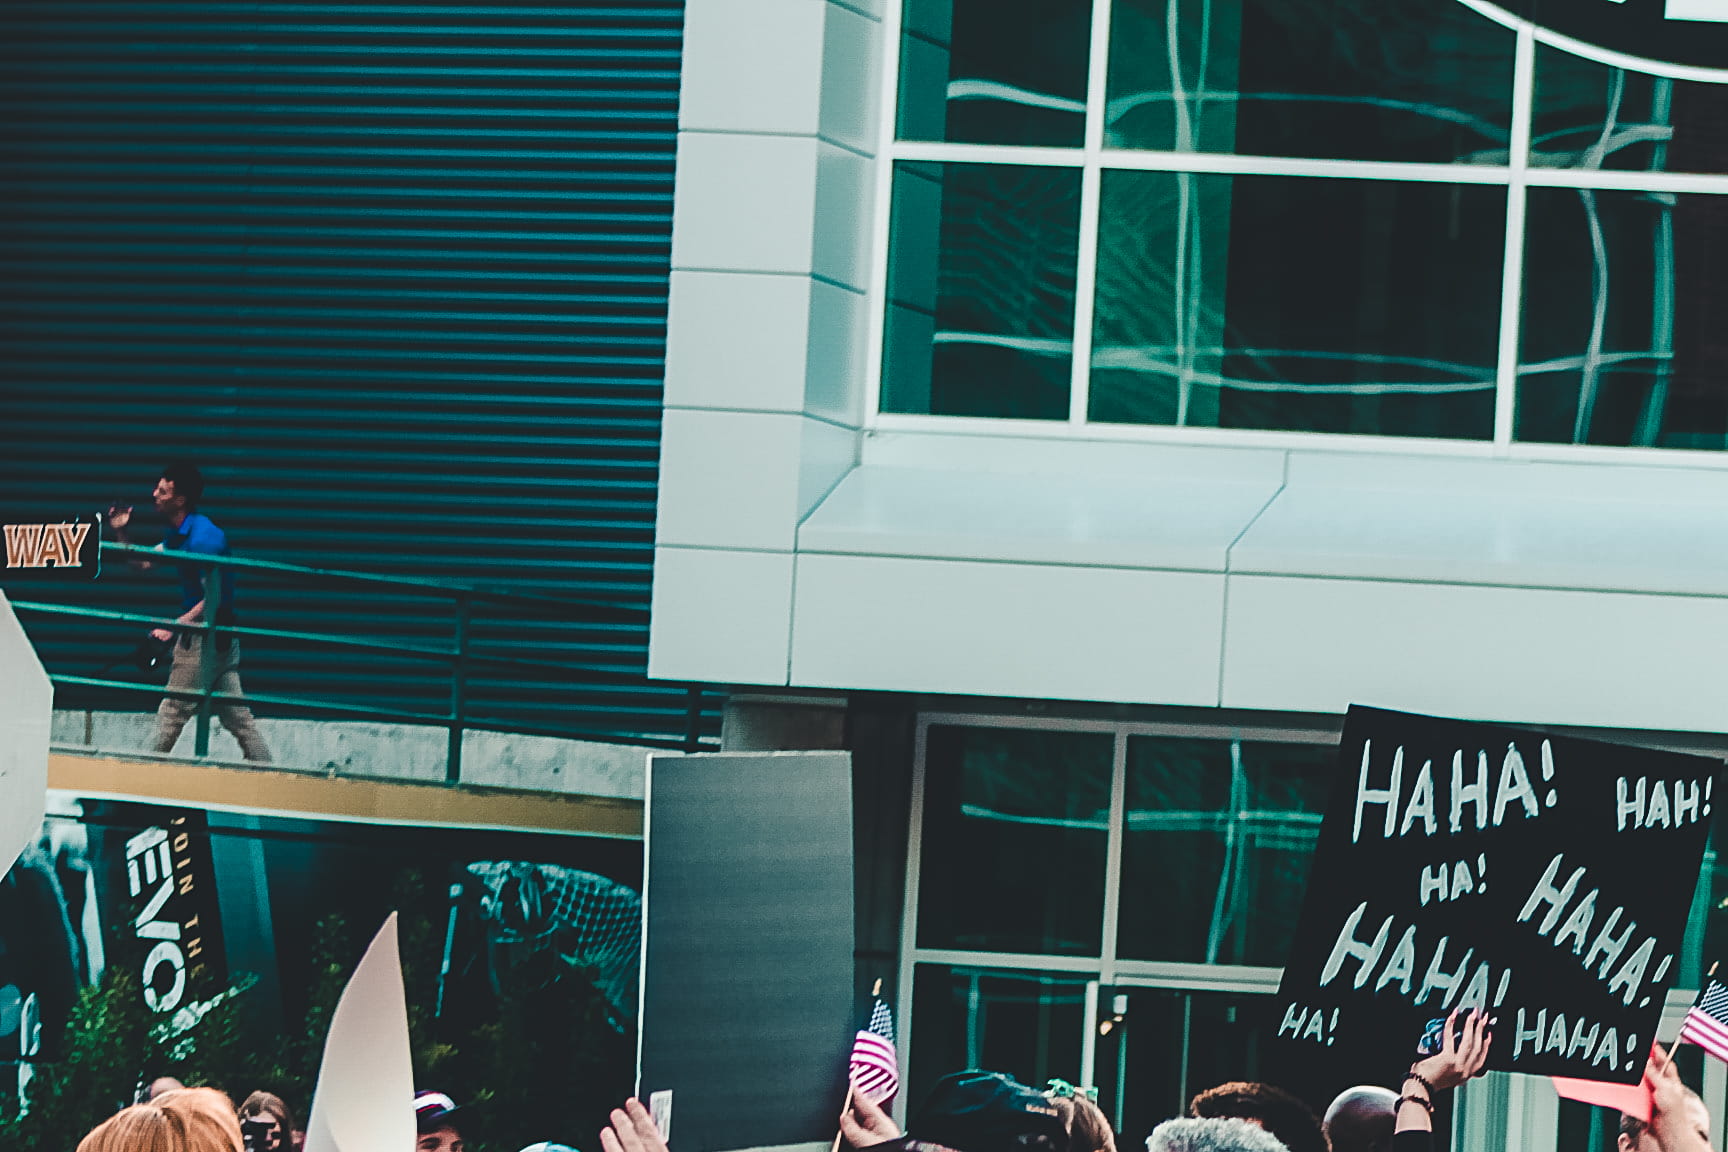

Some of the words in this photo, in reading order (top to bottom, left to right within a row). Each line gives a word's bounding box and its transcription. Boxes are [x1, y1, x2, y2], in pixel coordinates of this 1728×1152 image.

[3, 522, 92, 569] WAY
[1352, 738, 1558, 845] HAHA!
[1615, 775, 1713, 832] HAH!
[170, 815, 196, 896] JOIN
[1419, 852, 1488, 908] HA!
[1318, 900, 1512, 1026] HAHA!
[1516, 852, 1675, 1008] HAHA!
[1277, 1001, 1341, 1046] HA!
[1512, 1006, 1638, 1072] HAHA!
